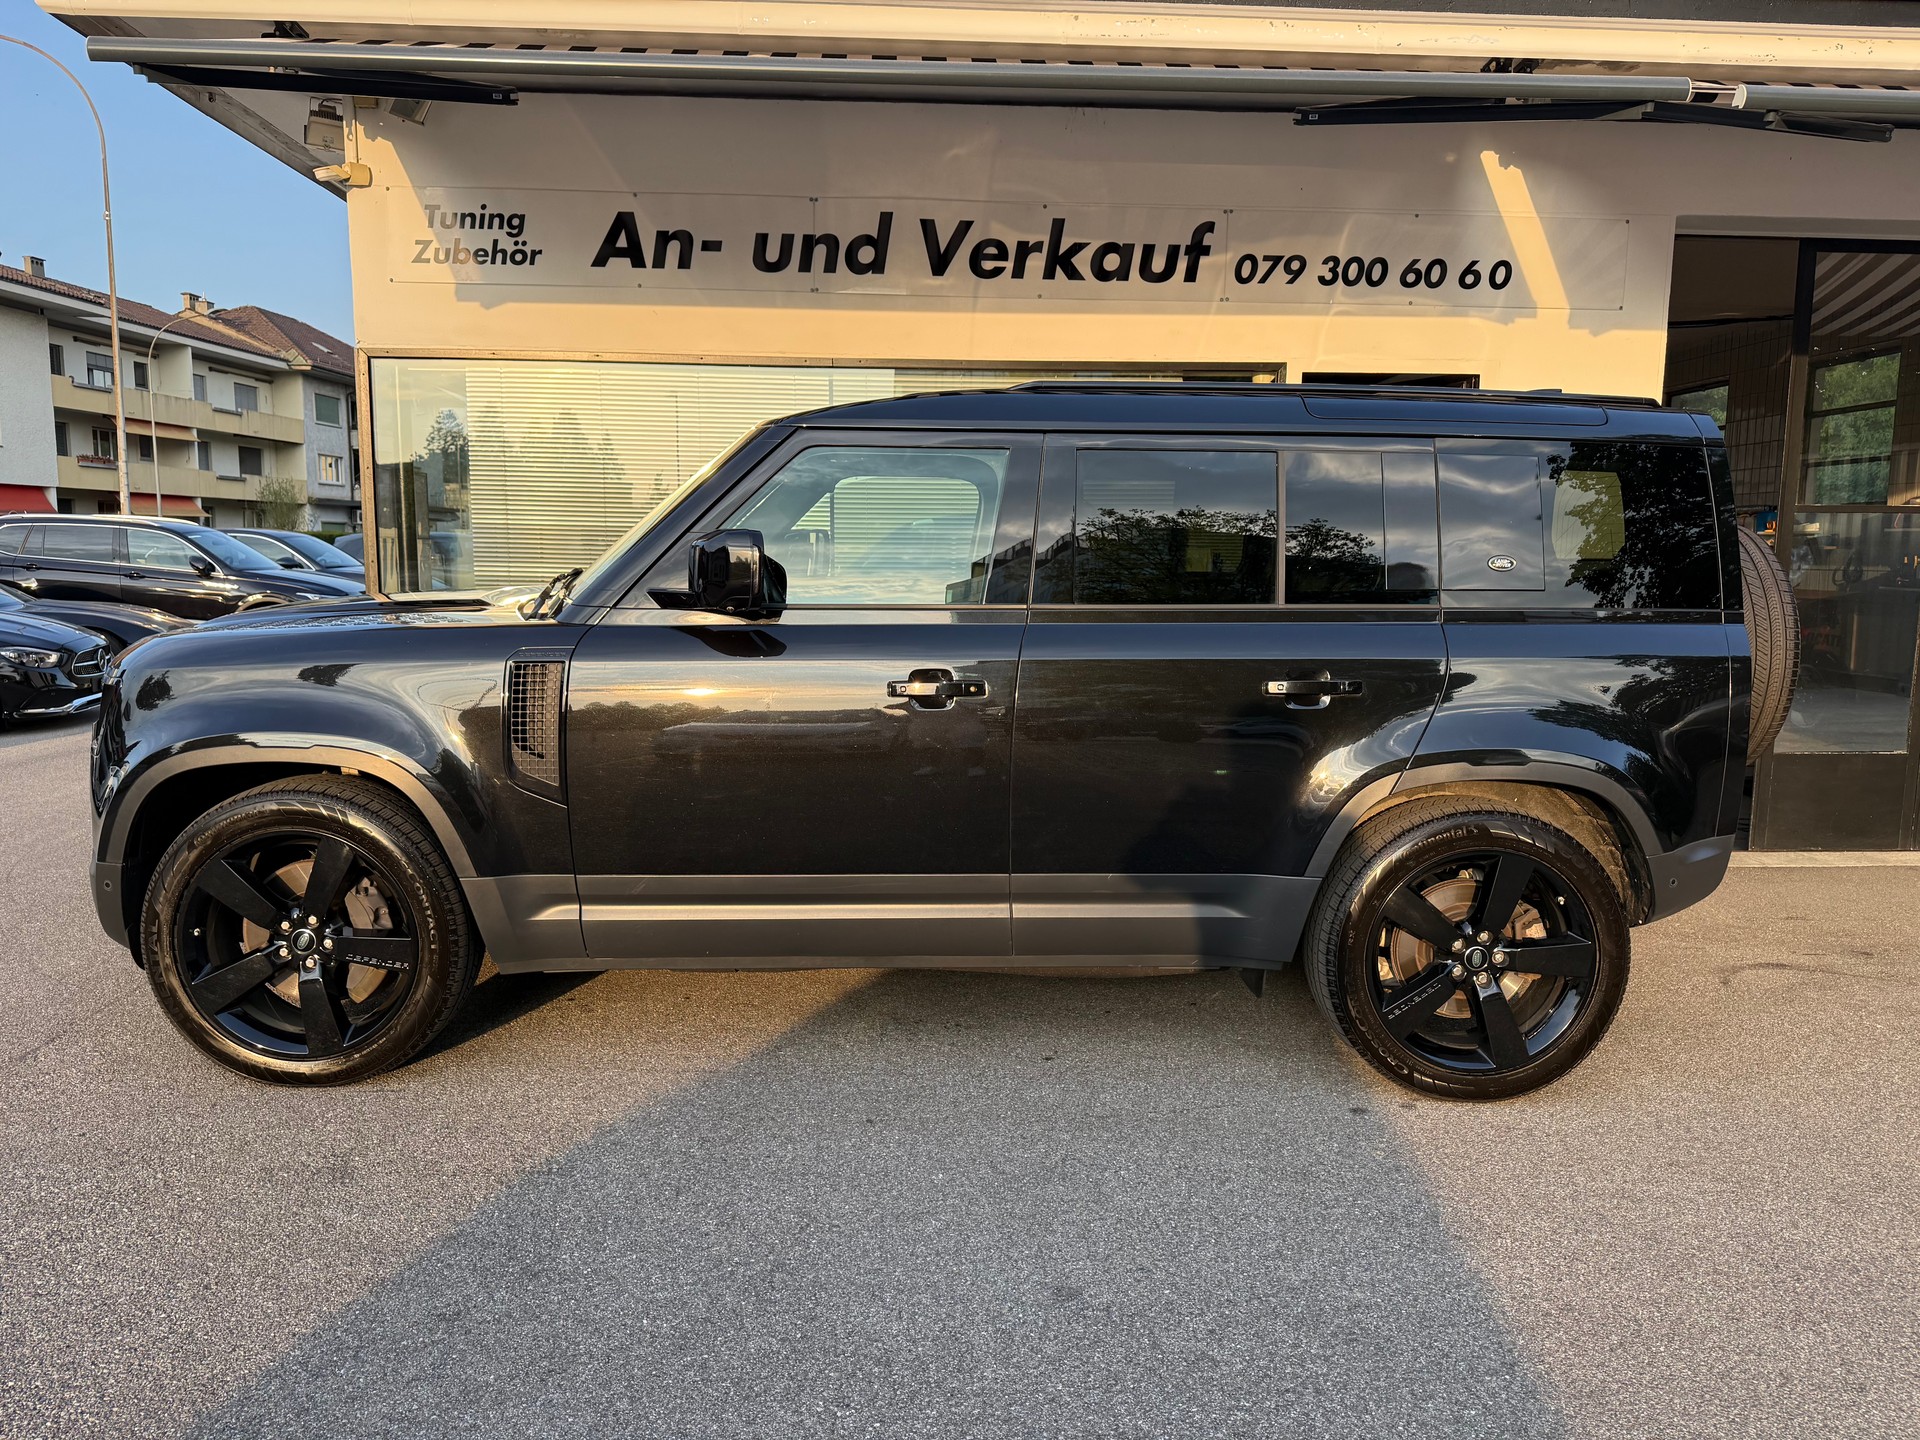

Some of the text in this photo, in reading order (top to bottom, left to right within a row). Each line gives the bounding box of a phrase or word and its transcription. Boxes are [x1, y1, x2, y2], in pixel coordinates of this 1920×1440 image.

[424, 203, 526, 238] Tuning
[411, 238, 543, 266] Zubehör
[590, 211, 1216, 284] An- und Verkauf
[1234, 253, 1307, 285] 079
[1317, 255, 1389, 288] 300
[1399, 258, 1448, 289] 60
